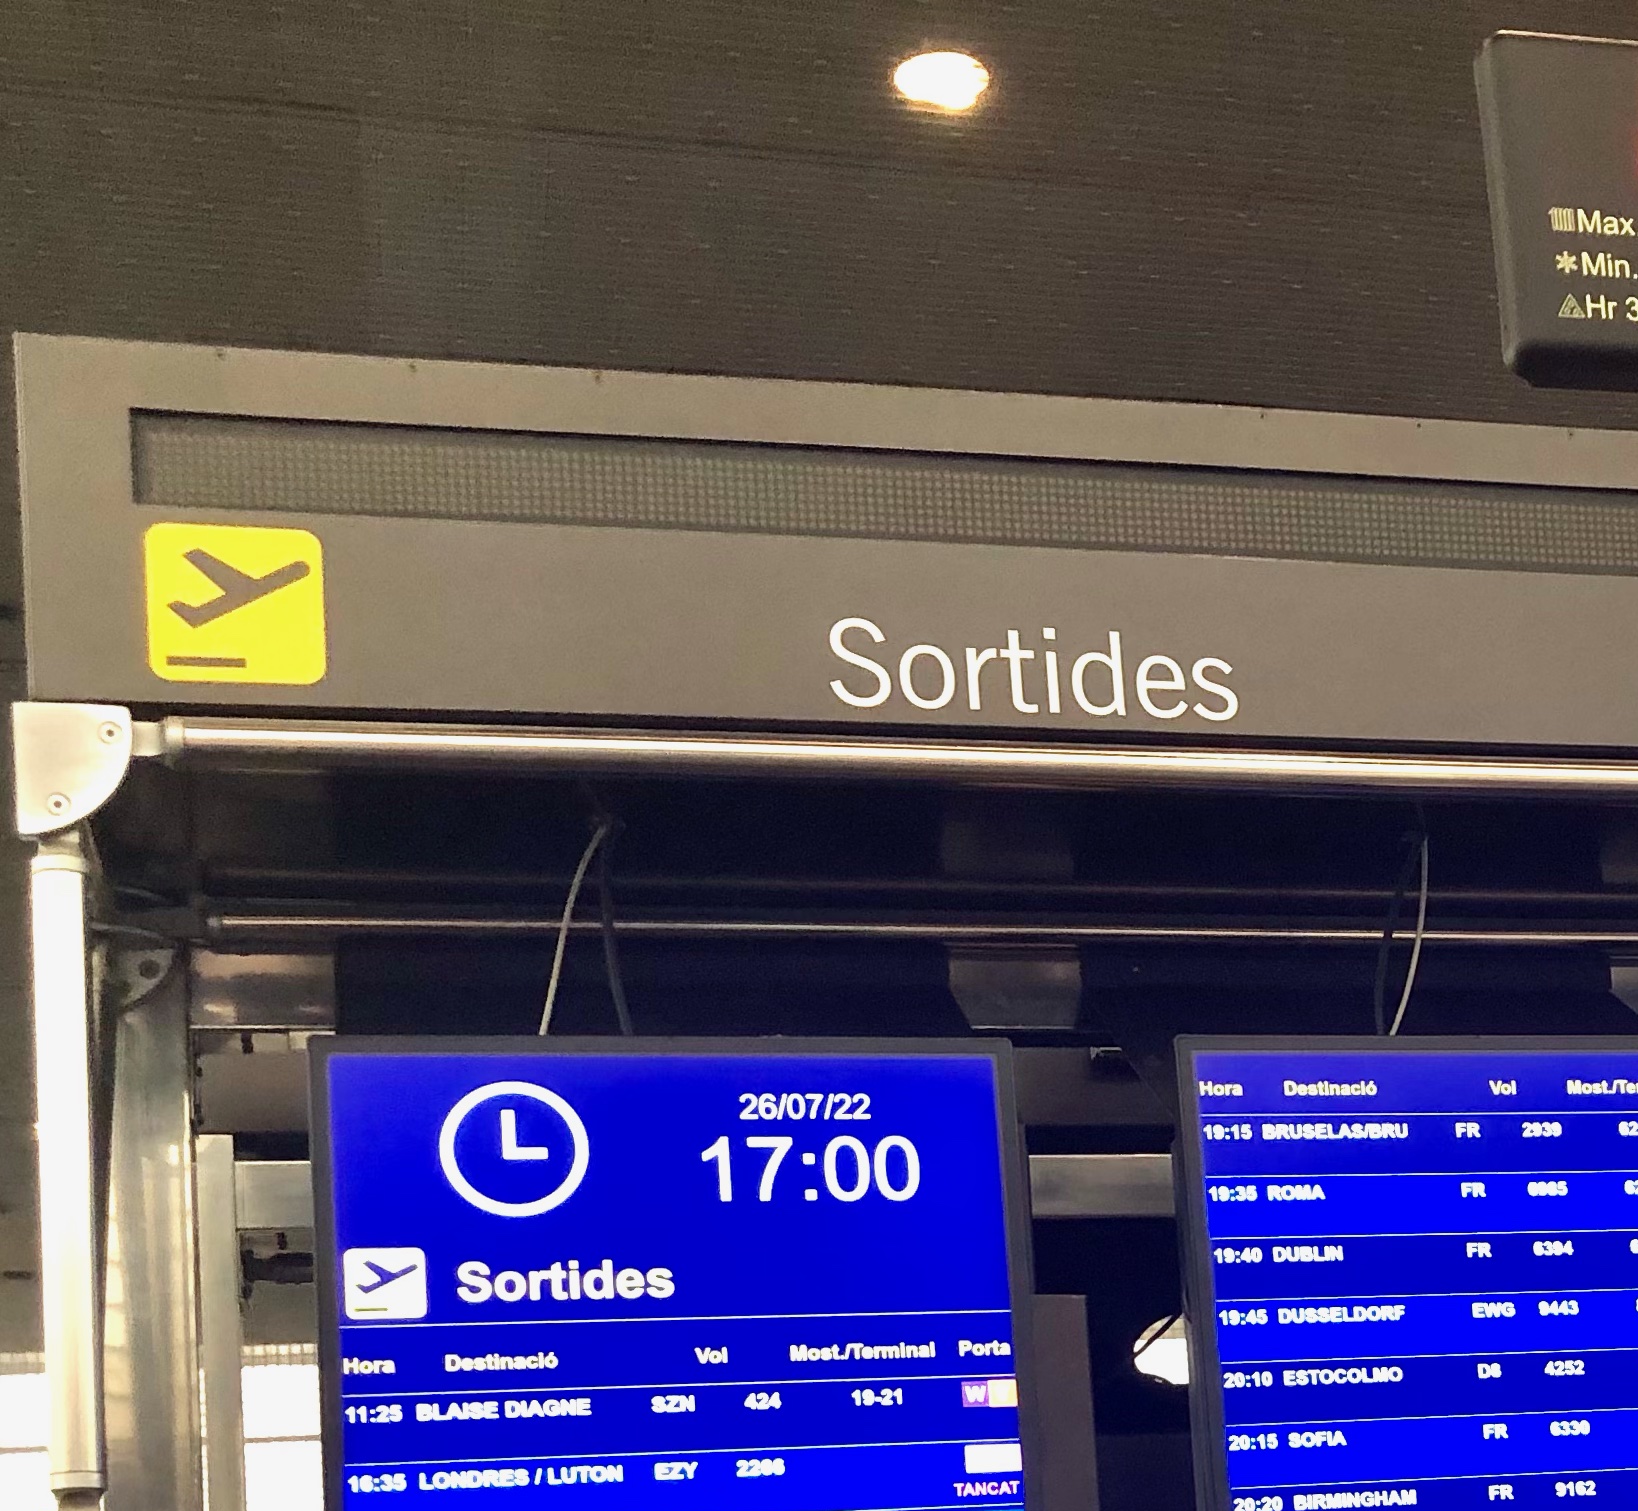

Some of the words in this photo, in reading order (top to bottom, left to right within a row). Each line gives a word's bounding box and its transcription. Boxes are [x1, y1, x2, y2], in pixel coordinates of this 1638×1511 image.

[1584, 293, 1619, 321] Hr
[827, 615, 1241, 722] Sortides
[1198, 1080, 1244, 1097] Hora
[1283, 1079, 1378, 1097] Destinació
[1488, 1079, 1517, 1096] Vol
[738, 1092, 872, 1121] 26/07/22
[1202, 1123, 1253, 1141] 19:15
[1261, 1122, 1409, 1141] BRUSELAS/BRU
[701, 1135, 921, 1203] 17:00
[1266, 1184, 1326, 1202] ROMA
[1213, 1246, 1263, 1264] 19:40
[1272, 1245, 1344, 1263] DUBLIN
[456, 1258, 676, 1304] Sortides
[1218, 1308, 1269, 1326] 19:45
[1277, 1304, 1406, 1325] DUSSELDORF
[342, 1357, 396, 1375] Hora
[444, 1351, 559, 1373] Destinació
[694, 1346, 729, 1365] Vol
[958, 1339, 1012, 1357] Porta
[1222, 1370, 1273, 1389] 20:10
[1282, 1366, 1404, 1387] ESTOCOLMO
[1544, 1359, 1586, 1376] 4252
[344, 1404, 404, 1424] 11:25
[415, 1400, 500, 1422] BLAISE
[504, 1397, 593, 1419] DIAGNE
[650, 1394, 696, 1414] SZN
[743, 1391, 782, 1411] 424
[850, 1387, 903, 1407] 19-21
[1228, 1432, 1279, 1452] 20:15
[1287, 1430, 1348, 1449] SOFIA
[418, 1468, 531, 1491] LONDRES
[546, 1464, 624, 1486] LUTON
[653, 1461, 699, 1481] EZY
[952, 1480, 1020, 1497] TANCAT
[1293, 1488, 1418, 1511] BIRMINGHAM
